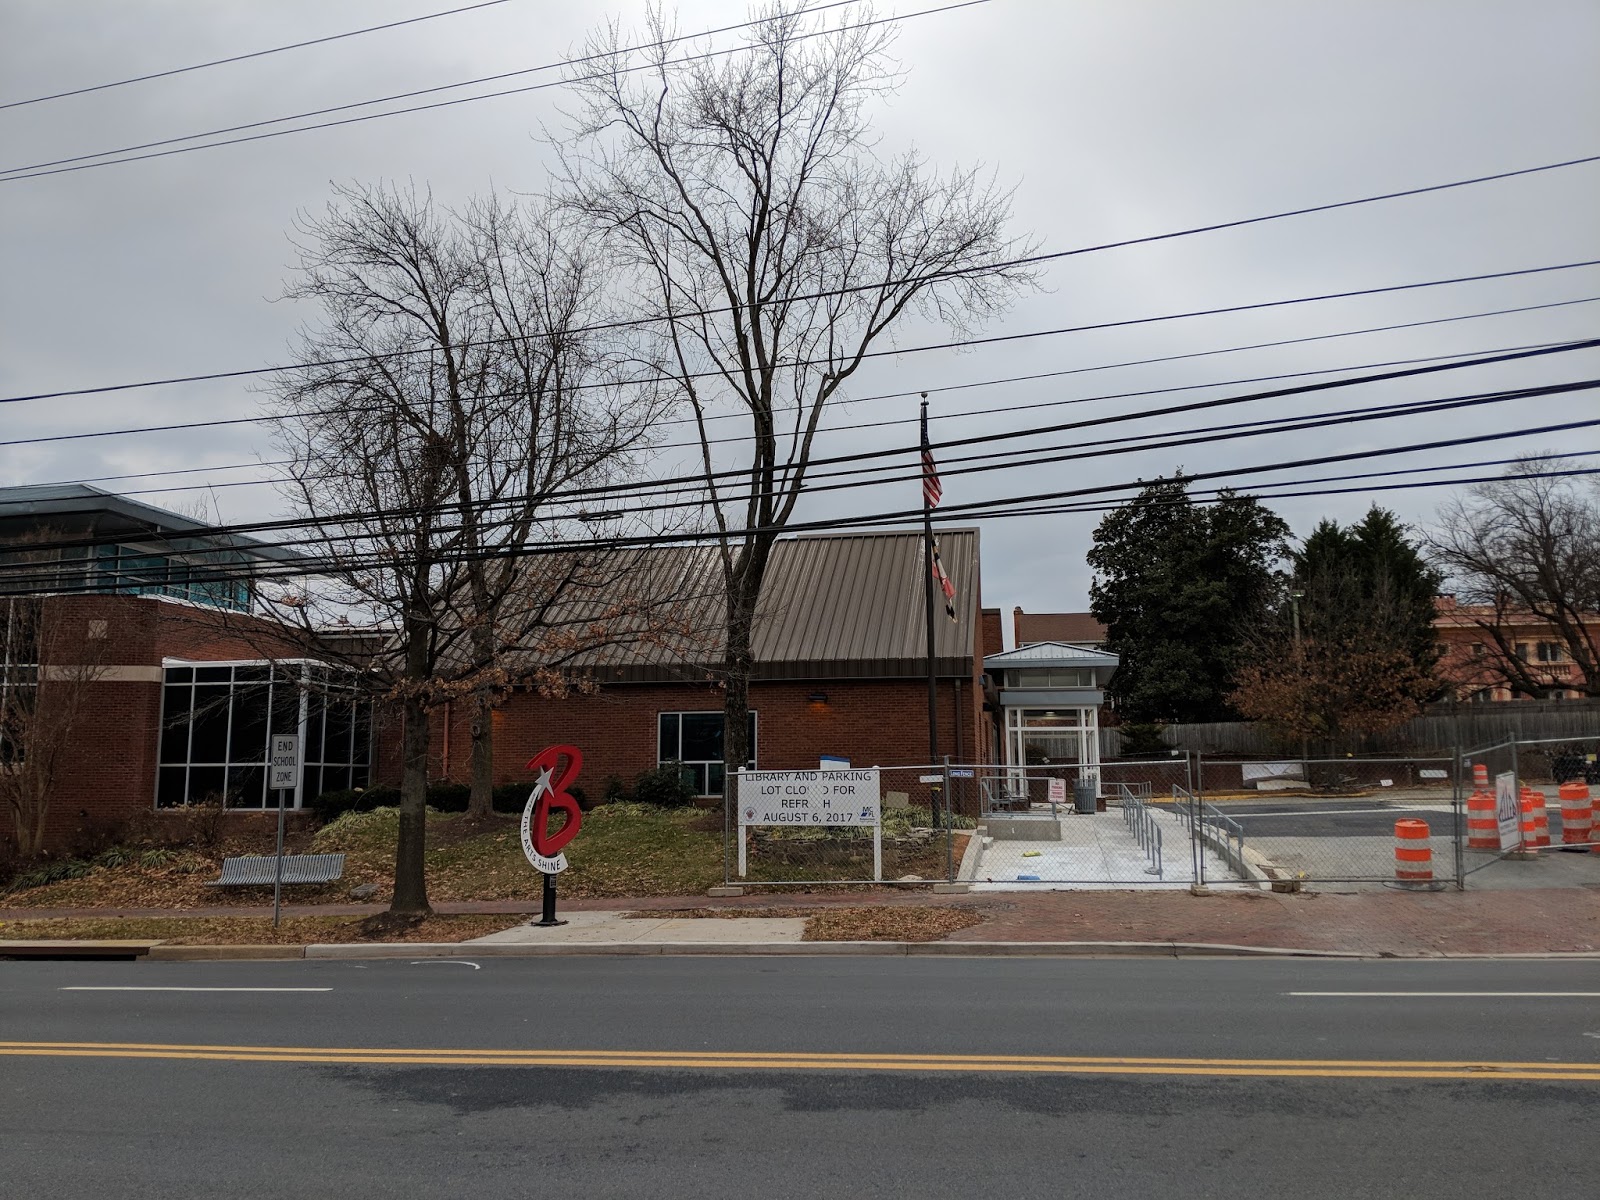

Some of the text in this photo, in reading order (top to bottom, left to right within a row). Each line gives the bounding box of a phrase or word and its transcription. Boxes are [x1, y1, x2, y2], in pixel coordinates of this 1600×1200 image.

[278, 741, 293, 751] END
[273, 756, 296, 767] SCHOOL
[276, 771, 292, 782] ZONE
[745, 771, 872, 781] LIBRARY AND PARKING
[761, 785, 856, 795] LOT CLOD FOR
[781, 799, 831, 809] REFRH
[763, 812, 809, 822] AUGUST
[812, 812, 822, 824] 6,
[826, 812, 853, 823] 2017
[523, 838, 537, 862] ARTS
[537, 858, 561, 872] SHINE
